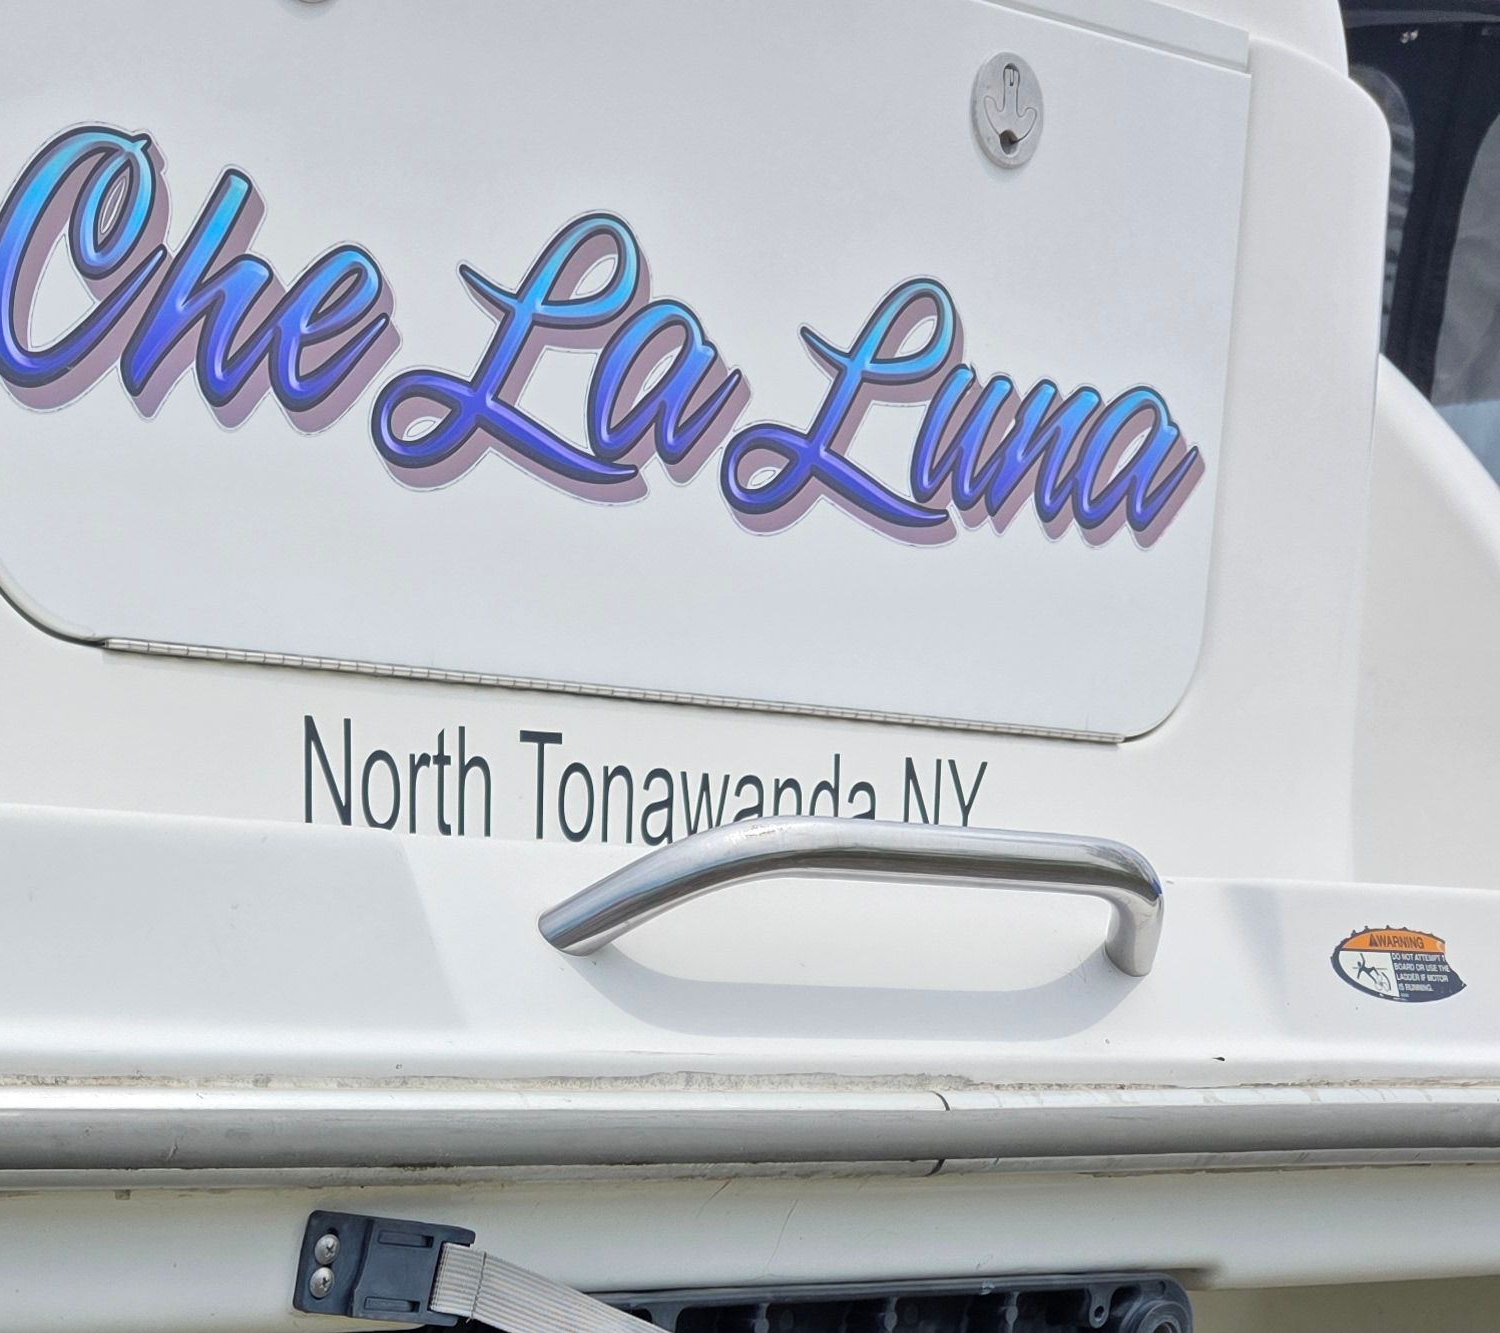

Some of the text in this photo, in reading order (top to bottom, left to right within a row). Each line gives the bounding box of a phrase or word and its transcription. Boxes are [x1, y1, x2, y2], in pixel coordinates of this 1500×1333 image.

[370, 209, 751, 508] La
[720, 274, 1206, 548] Luna
[303, 714, 988, 845] North Tonawanda NY
[1376, 934, 1424, 949] WARNING
